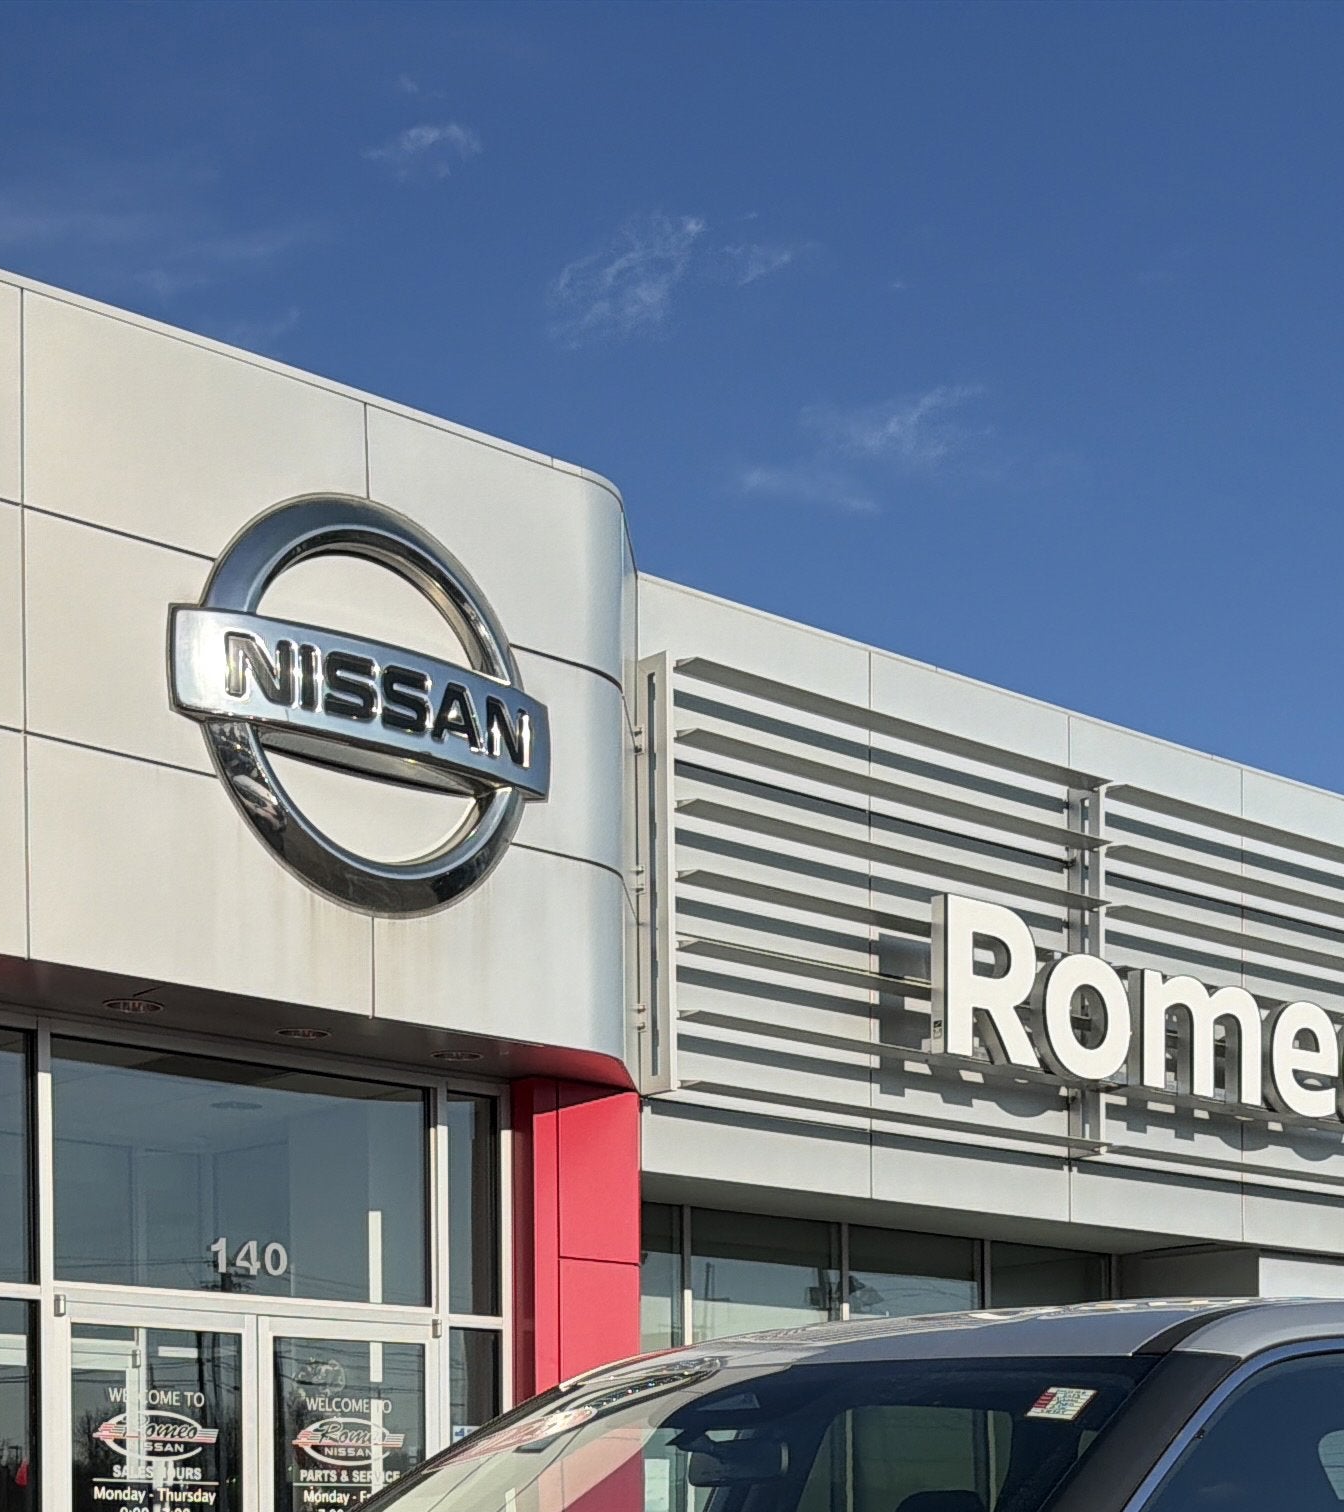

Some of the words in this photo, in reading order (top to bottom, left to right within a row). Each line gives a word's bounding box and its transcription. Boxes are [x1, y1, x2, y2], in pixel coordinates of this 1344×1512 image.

[224, 631, 533, 770] NISSAN
[210, 1237, 289, 1277] 140
[108, 1387, 181, 1406] WEOME
[184, 1391, 205, 1408] TO
[305, 1397, 371, 1413] WELCOME
[299, 1469, 338, 1482] PARTS
[340, 1470, 349, 1482] &
[93, 1485, 146, 1504] Monday
[156, 1487, 216, 1506] Thursday
[303, 1489, 350, 1506] Monday
